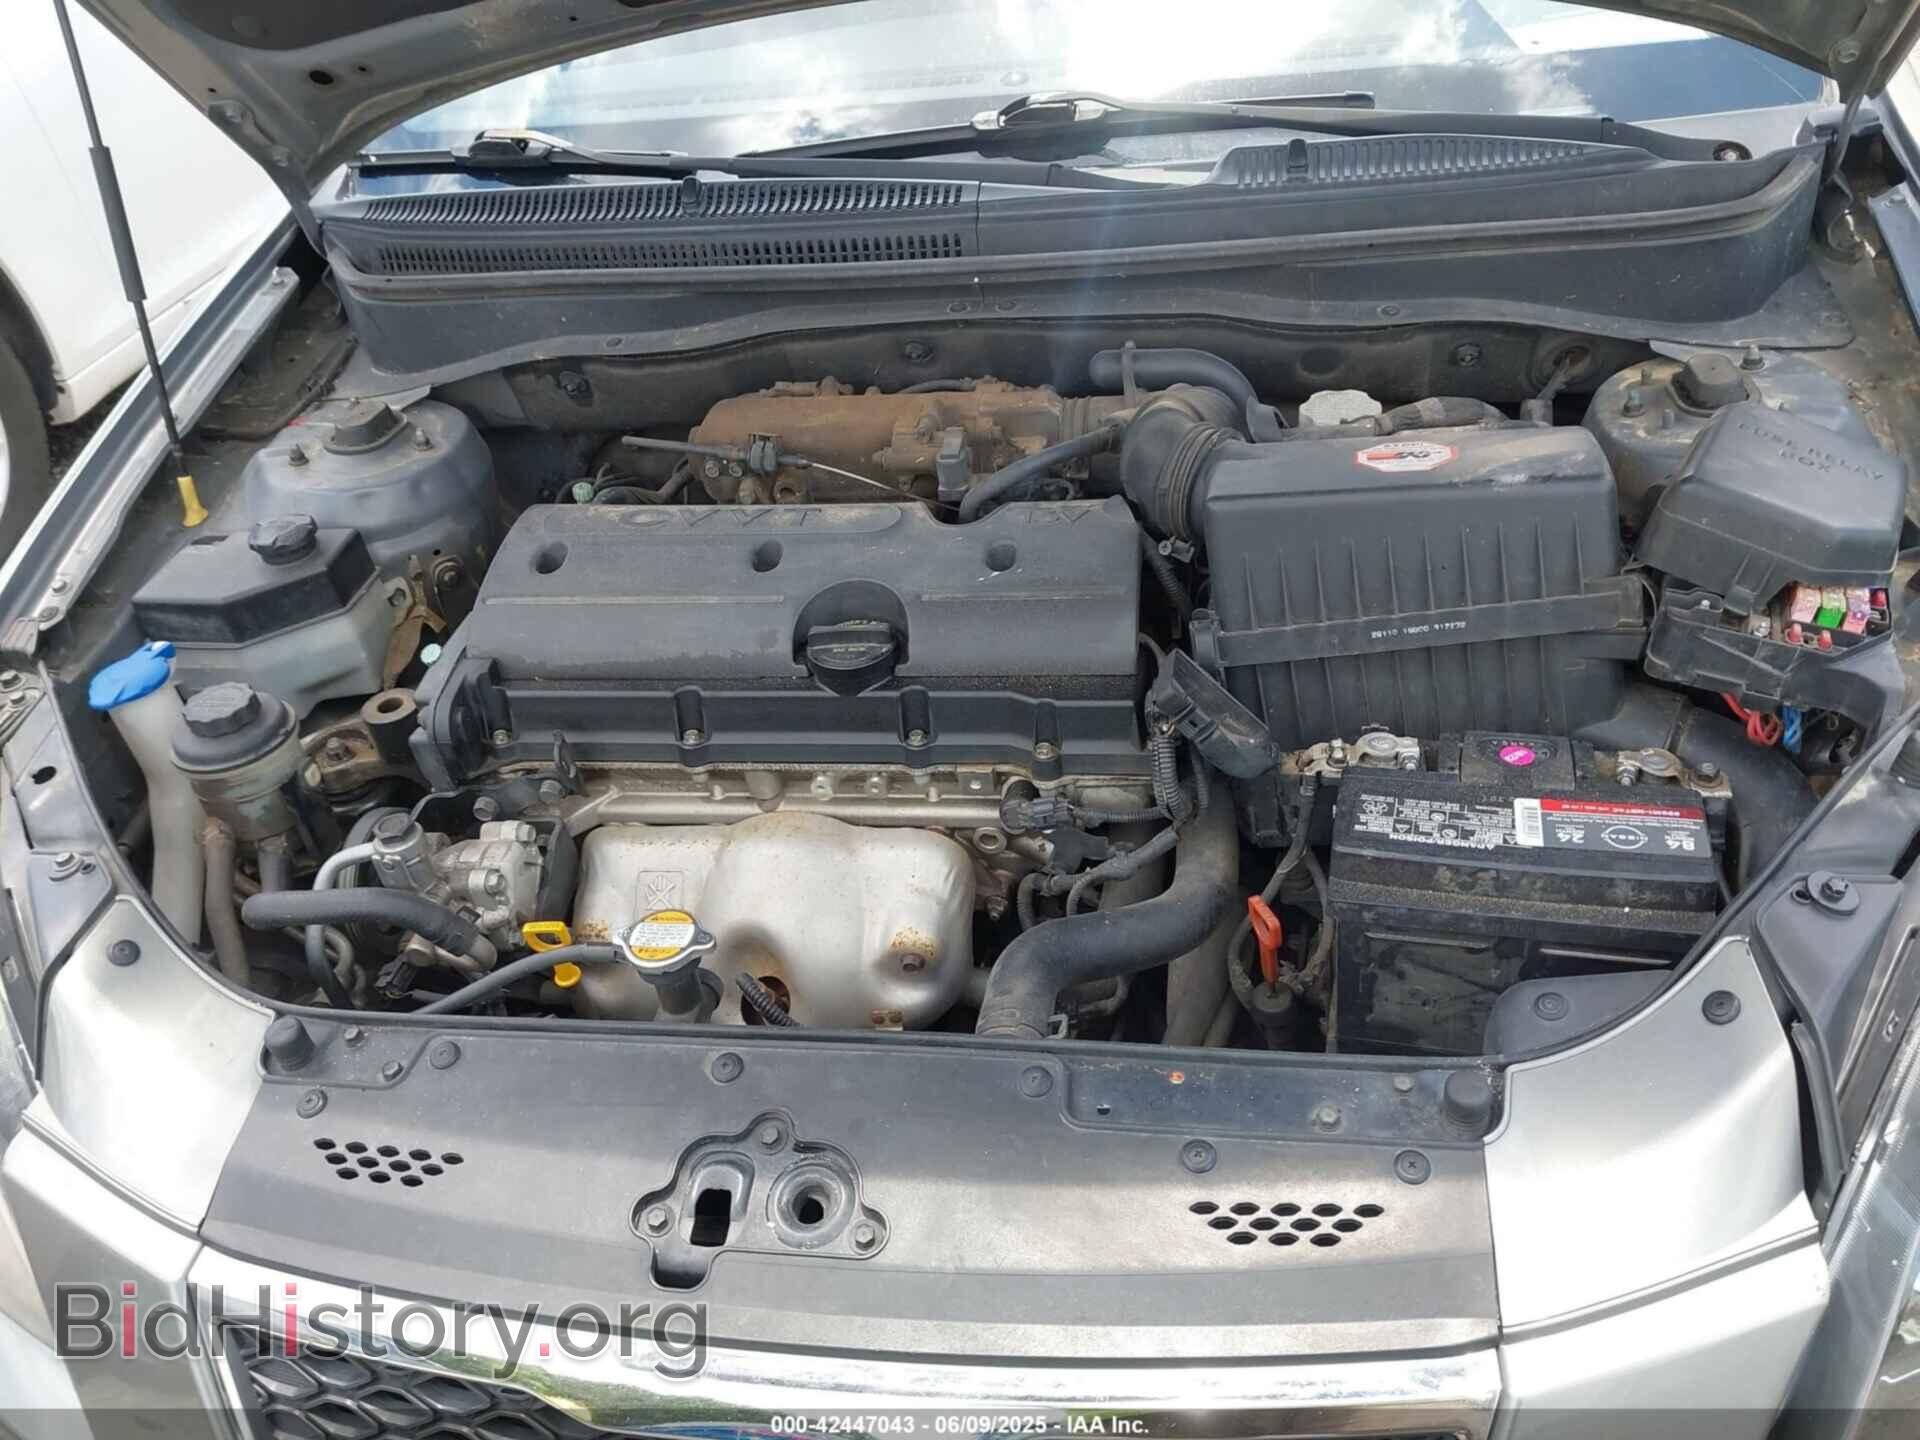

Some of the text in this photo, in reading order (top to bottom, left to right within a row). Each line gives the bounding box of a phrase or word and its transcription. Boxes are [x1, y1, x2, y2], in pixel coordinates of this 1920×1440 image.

[1778, 448, 1831, 474] BOX
[618, 507, 822, 528] CVVT
[1665, 839, 1696, 851] 84
